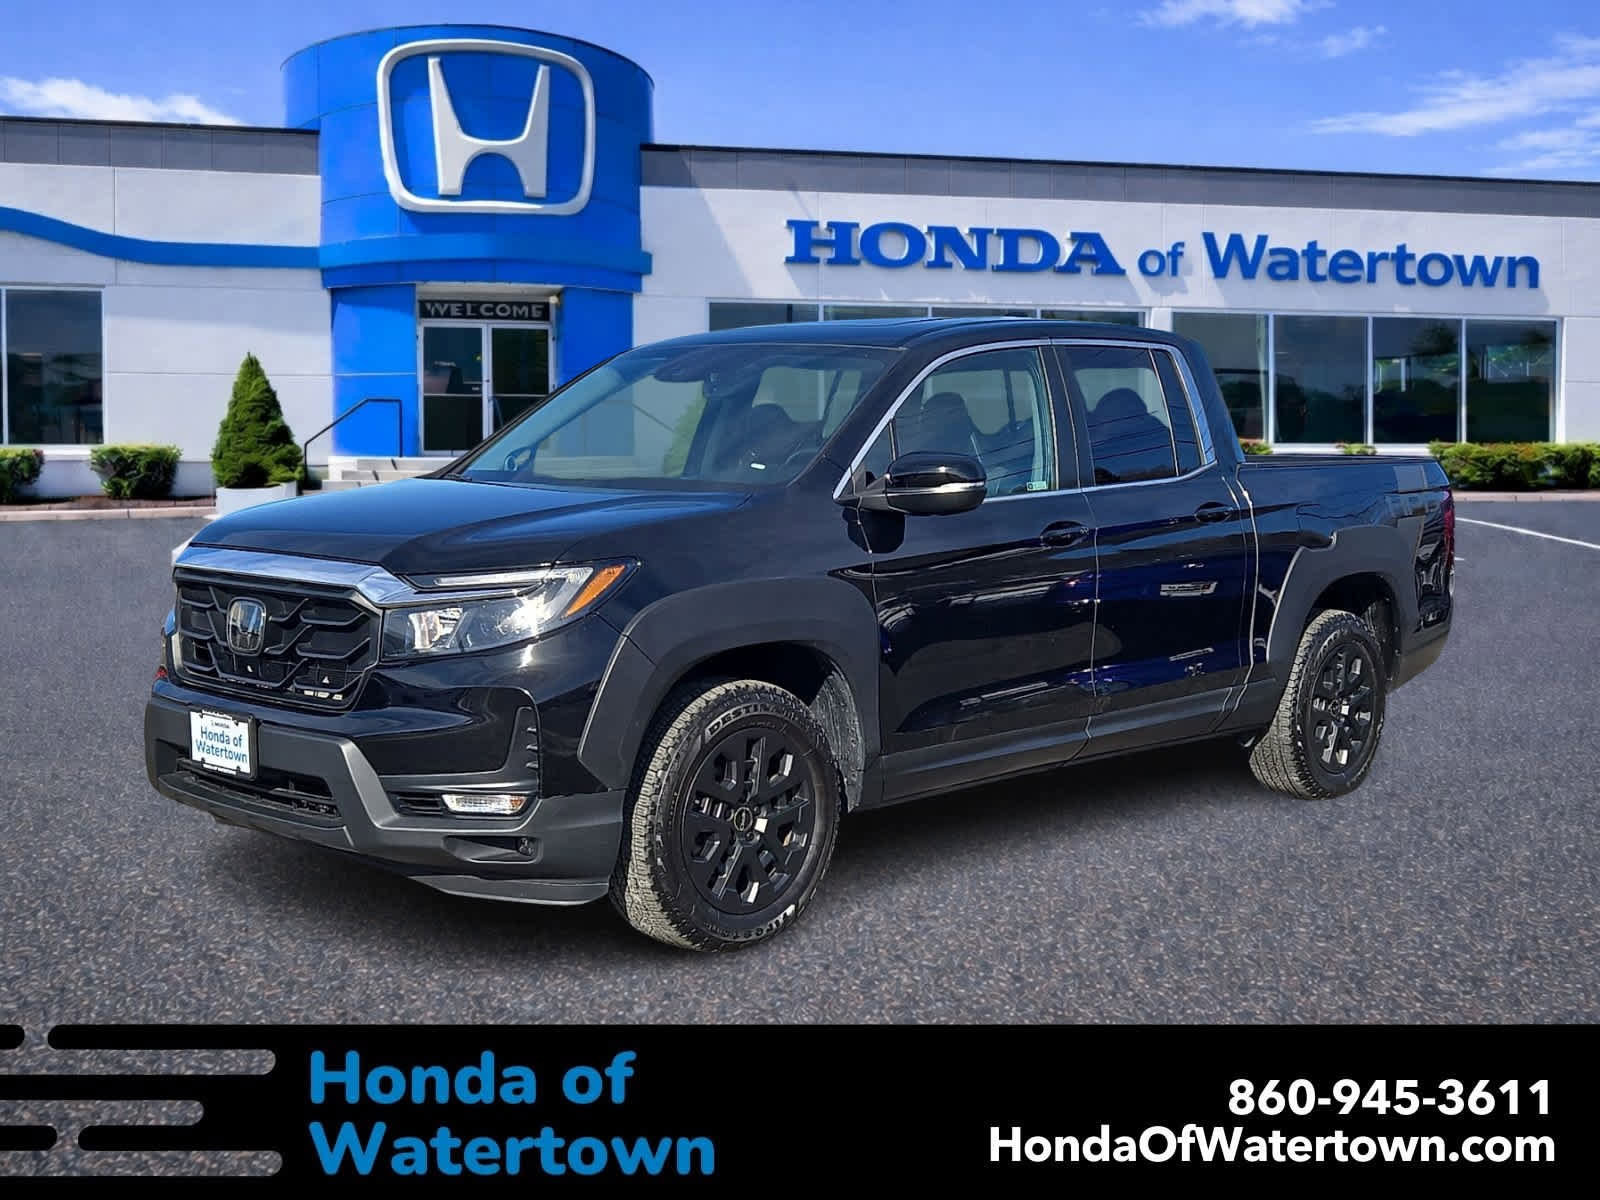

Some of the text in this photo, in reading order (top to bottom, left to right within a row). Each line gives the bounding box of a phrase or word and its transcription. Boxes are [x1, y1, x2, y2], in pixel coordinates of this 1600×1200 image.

[785, 219, 1539, 289] HONDA of Watertown
[425, 303, 545, 318] WELCOME
[200, 726, 243, 748] Honda of
[195, 739, 248, 763] Watertown
